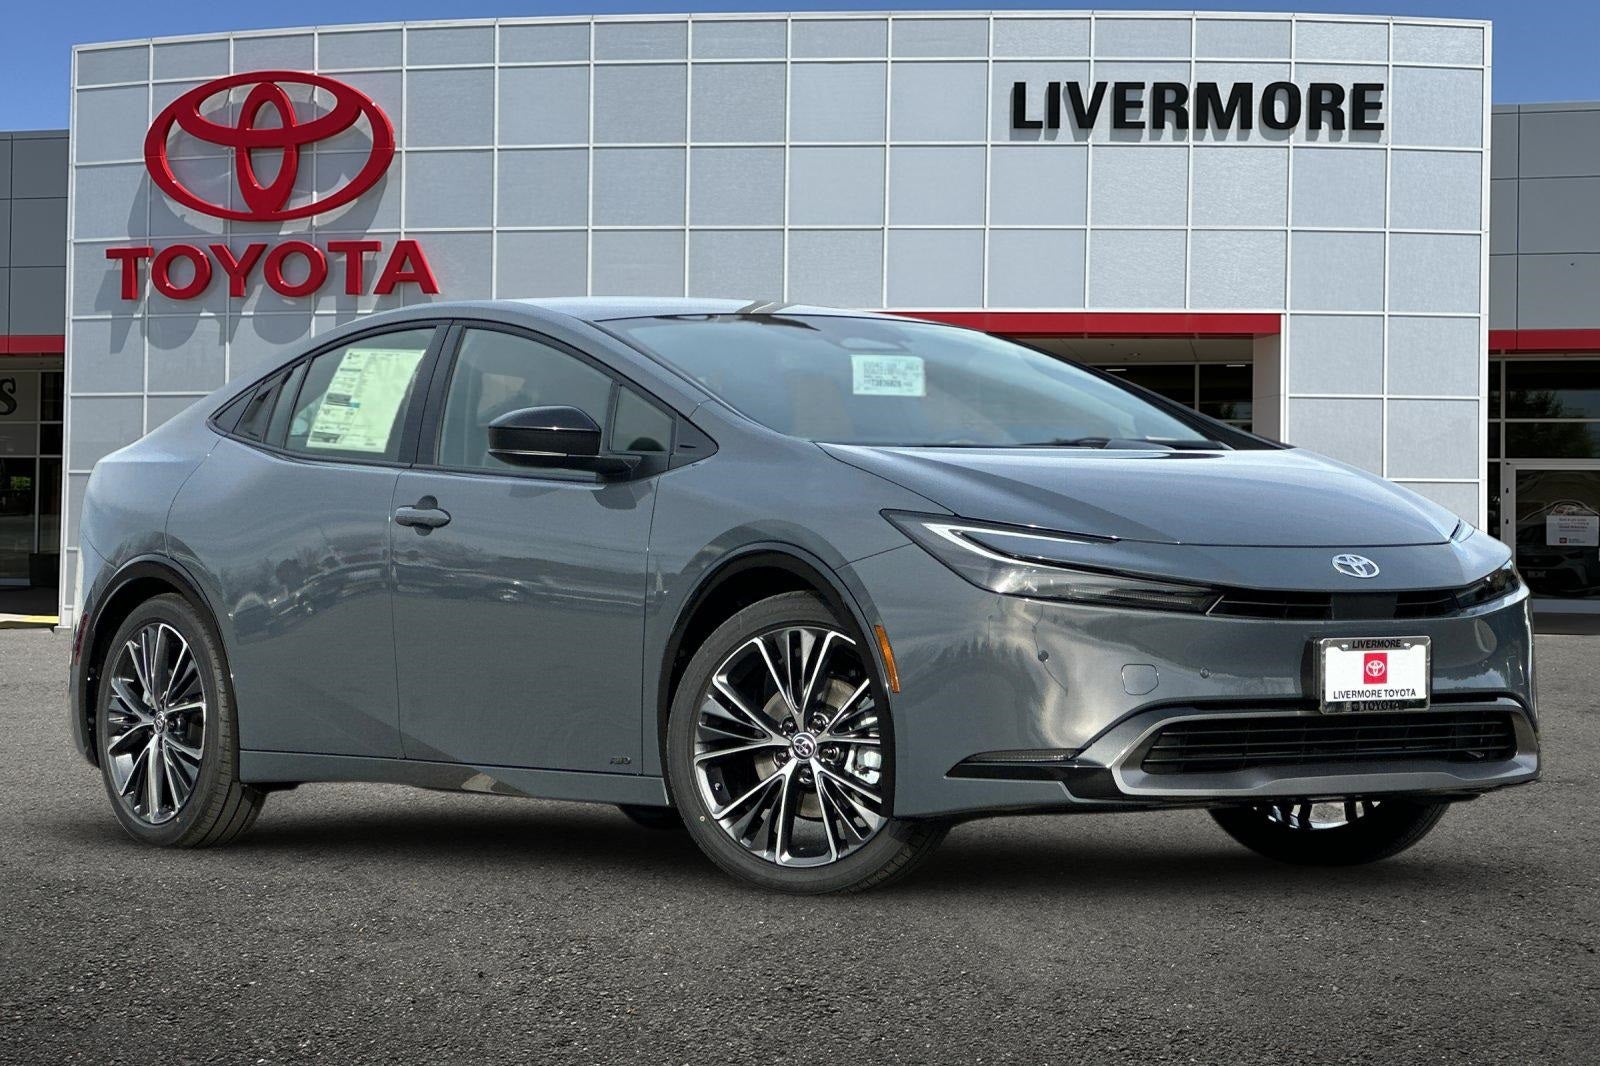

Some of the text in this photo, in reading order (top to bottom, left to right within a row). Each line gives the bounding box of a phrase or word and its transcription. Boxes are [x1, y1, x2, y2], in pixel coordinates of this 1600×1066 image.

[1013, 81, 1385, 131] LIVERMORE
[106, 239, 440, 300] TOYOTA
[1352, 640, 1401, 649] LIVERMORE
[1333, 688, 1416, 699] LIVERMORE TOYOTA
[1363, 701, 1401, 711] TOYOTA
